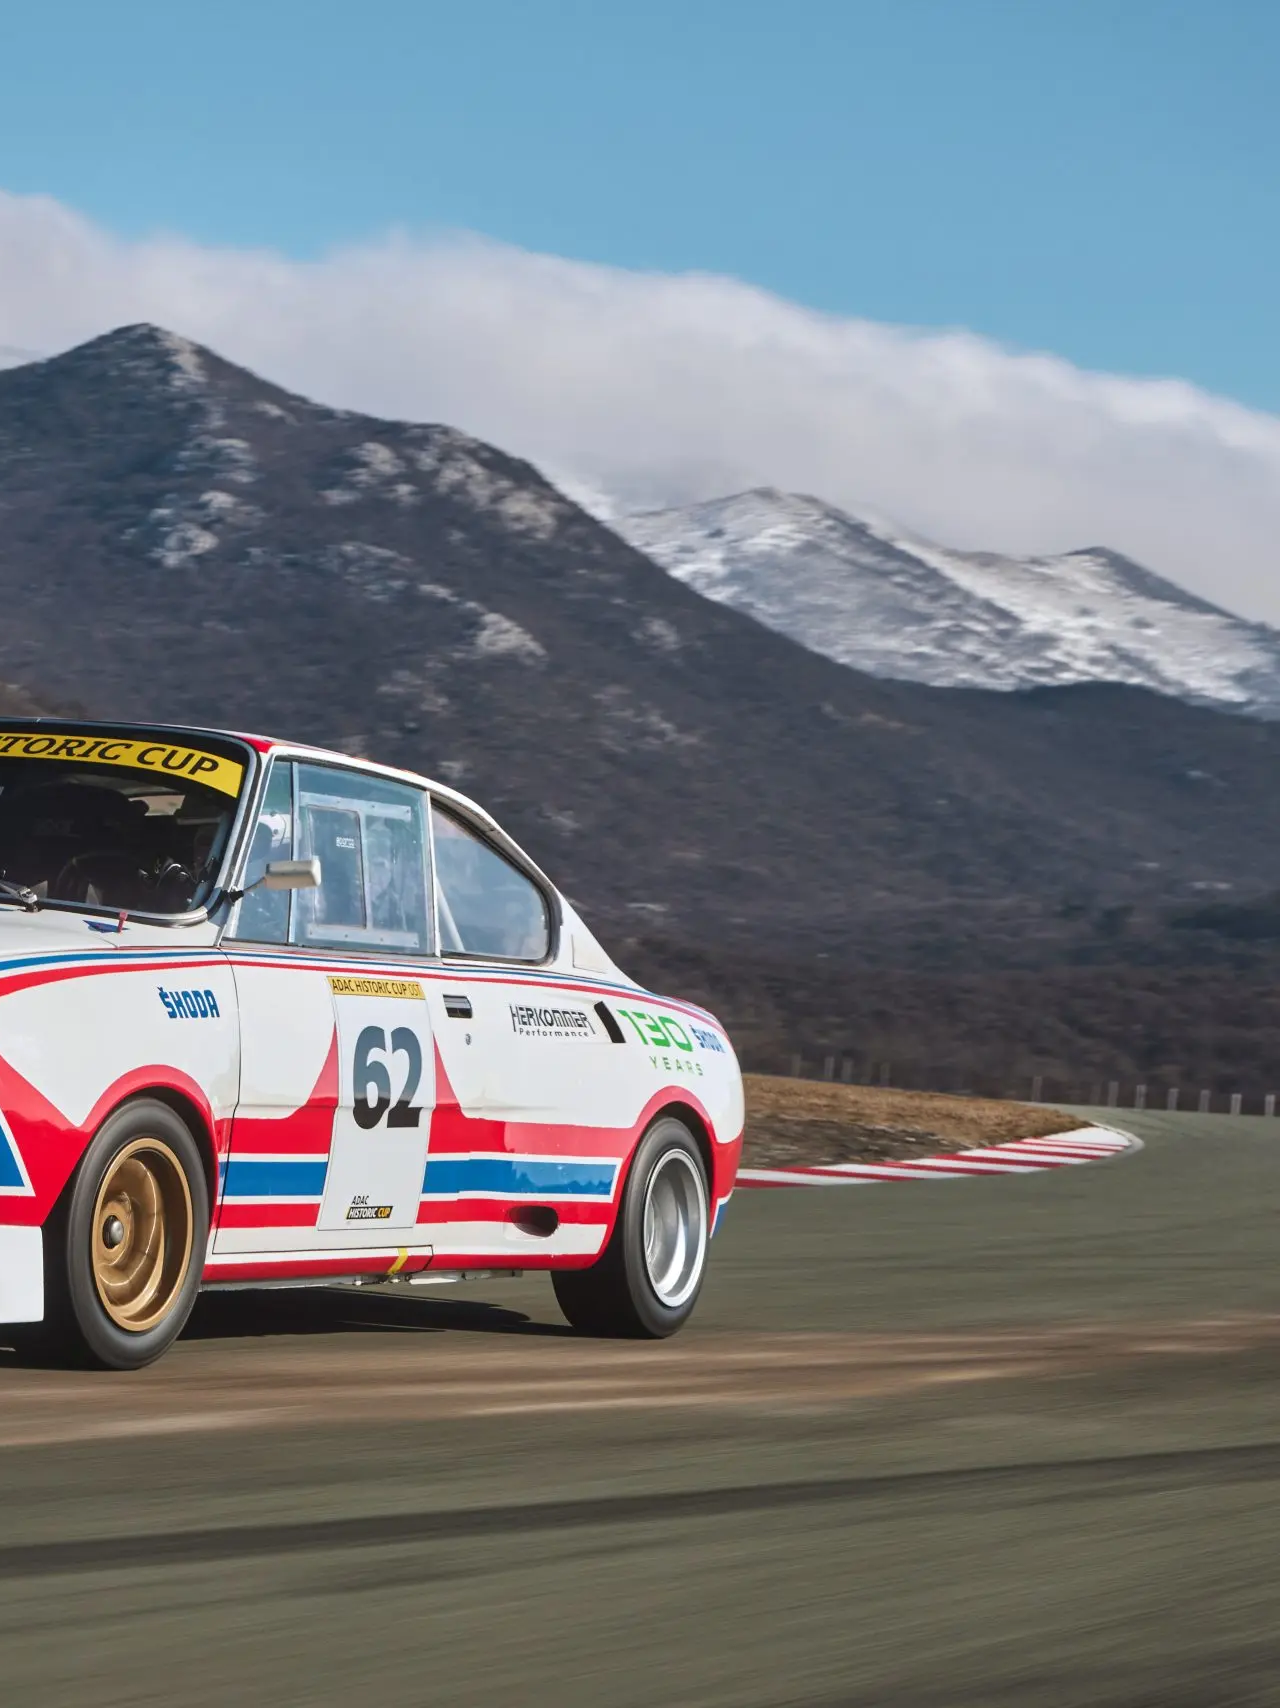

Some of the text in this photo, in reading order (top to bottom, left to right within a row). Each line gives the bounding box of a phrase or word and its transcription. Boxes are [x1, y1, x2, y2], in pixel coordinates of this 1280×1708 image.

[136, 746, 219, 776] CUP
[332, 978, 355, 993] ADAC
[355, 980, 392, 994] HISTORIC
[391, 982, 407, 995] CUP
[157, 986, 221, 1019] ŠKODA
[509, 1004, 596, 1035] HERKOMMER
[616, 1009, 694, 1052] 130
[519, 1027, 589, 1038] Performance
[352, 1025, 424, 1130] 62
[649, 1055, 704, 1076] YEARS
[348, 1207, 391, 1218] HISTORIC CUP
[351, 1195, 369, 1206] ADAC
